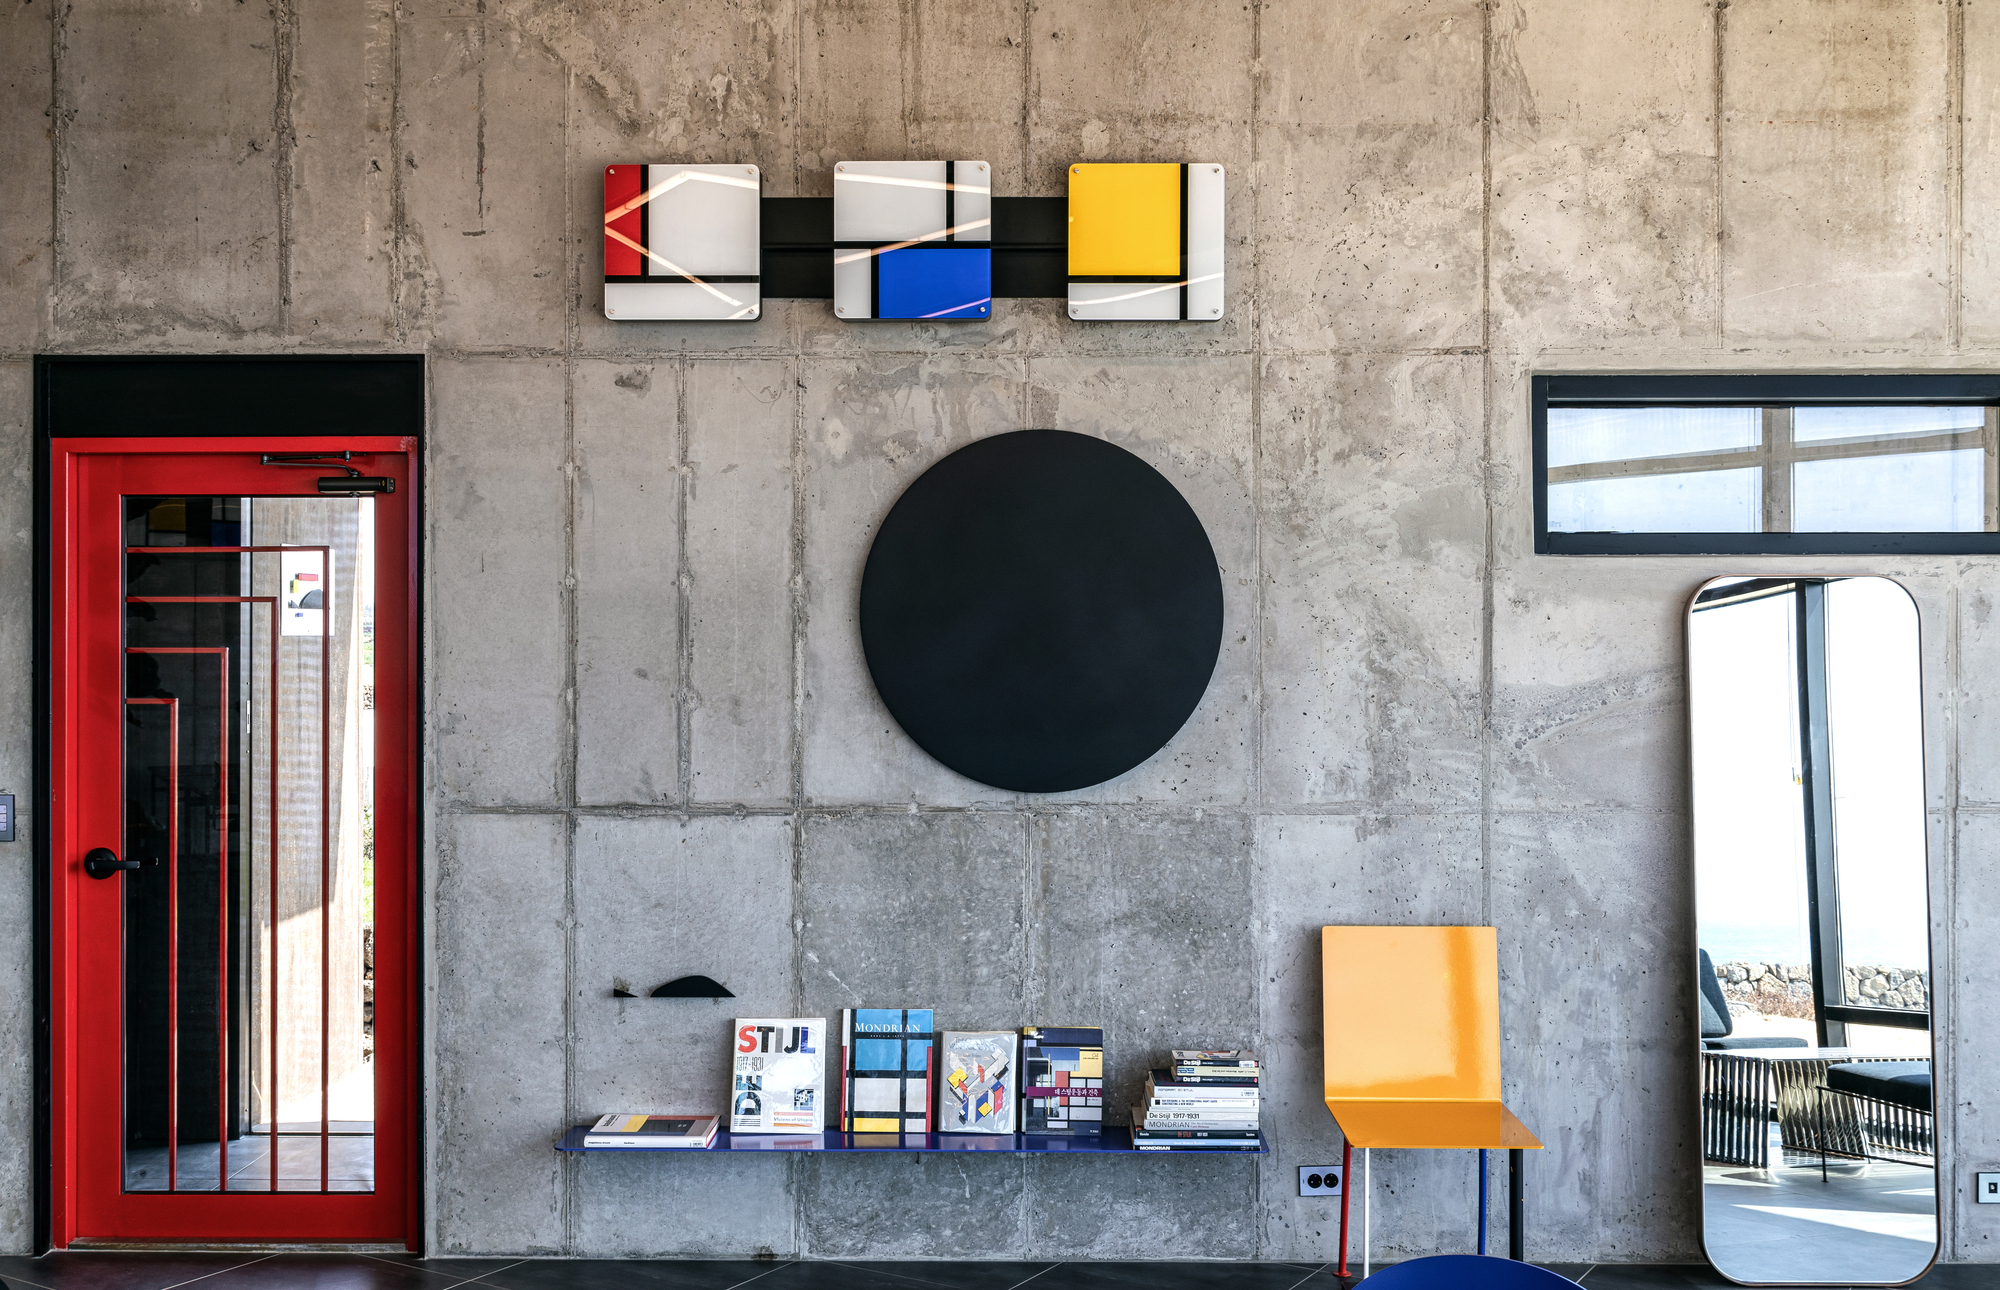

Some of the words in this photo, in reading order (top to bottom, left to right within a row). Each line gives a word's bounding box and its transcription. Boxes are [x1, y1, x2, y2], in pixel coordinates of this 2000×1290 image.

[855, 1022, 921, 1033] MONDRIAN
[737, 1025, 816, 1054] STIJL
[736, 1057, 764, 1071] 1917-1931
